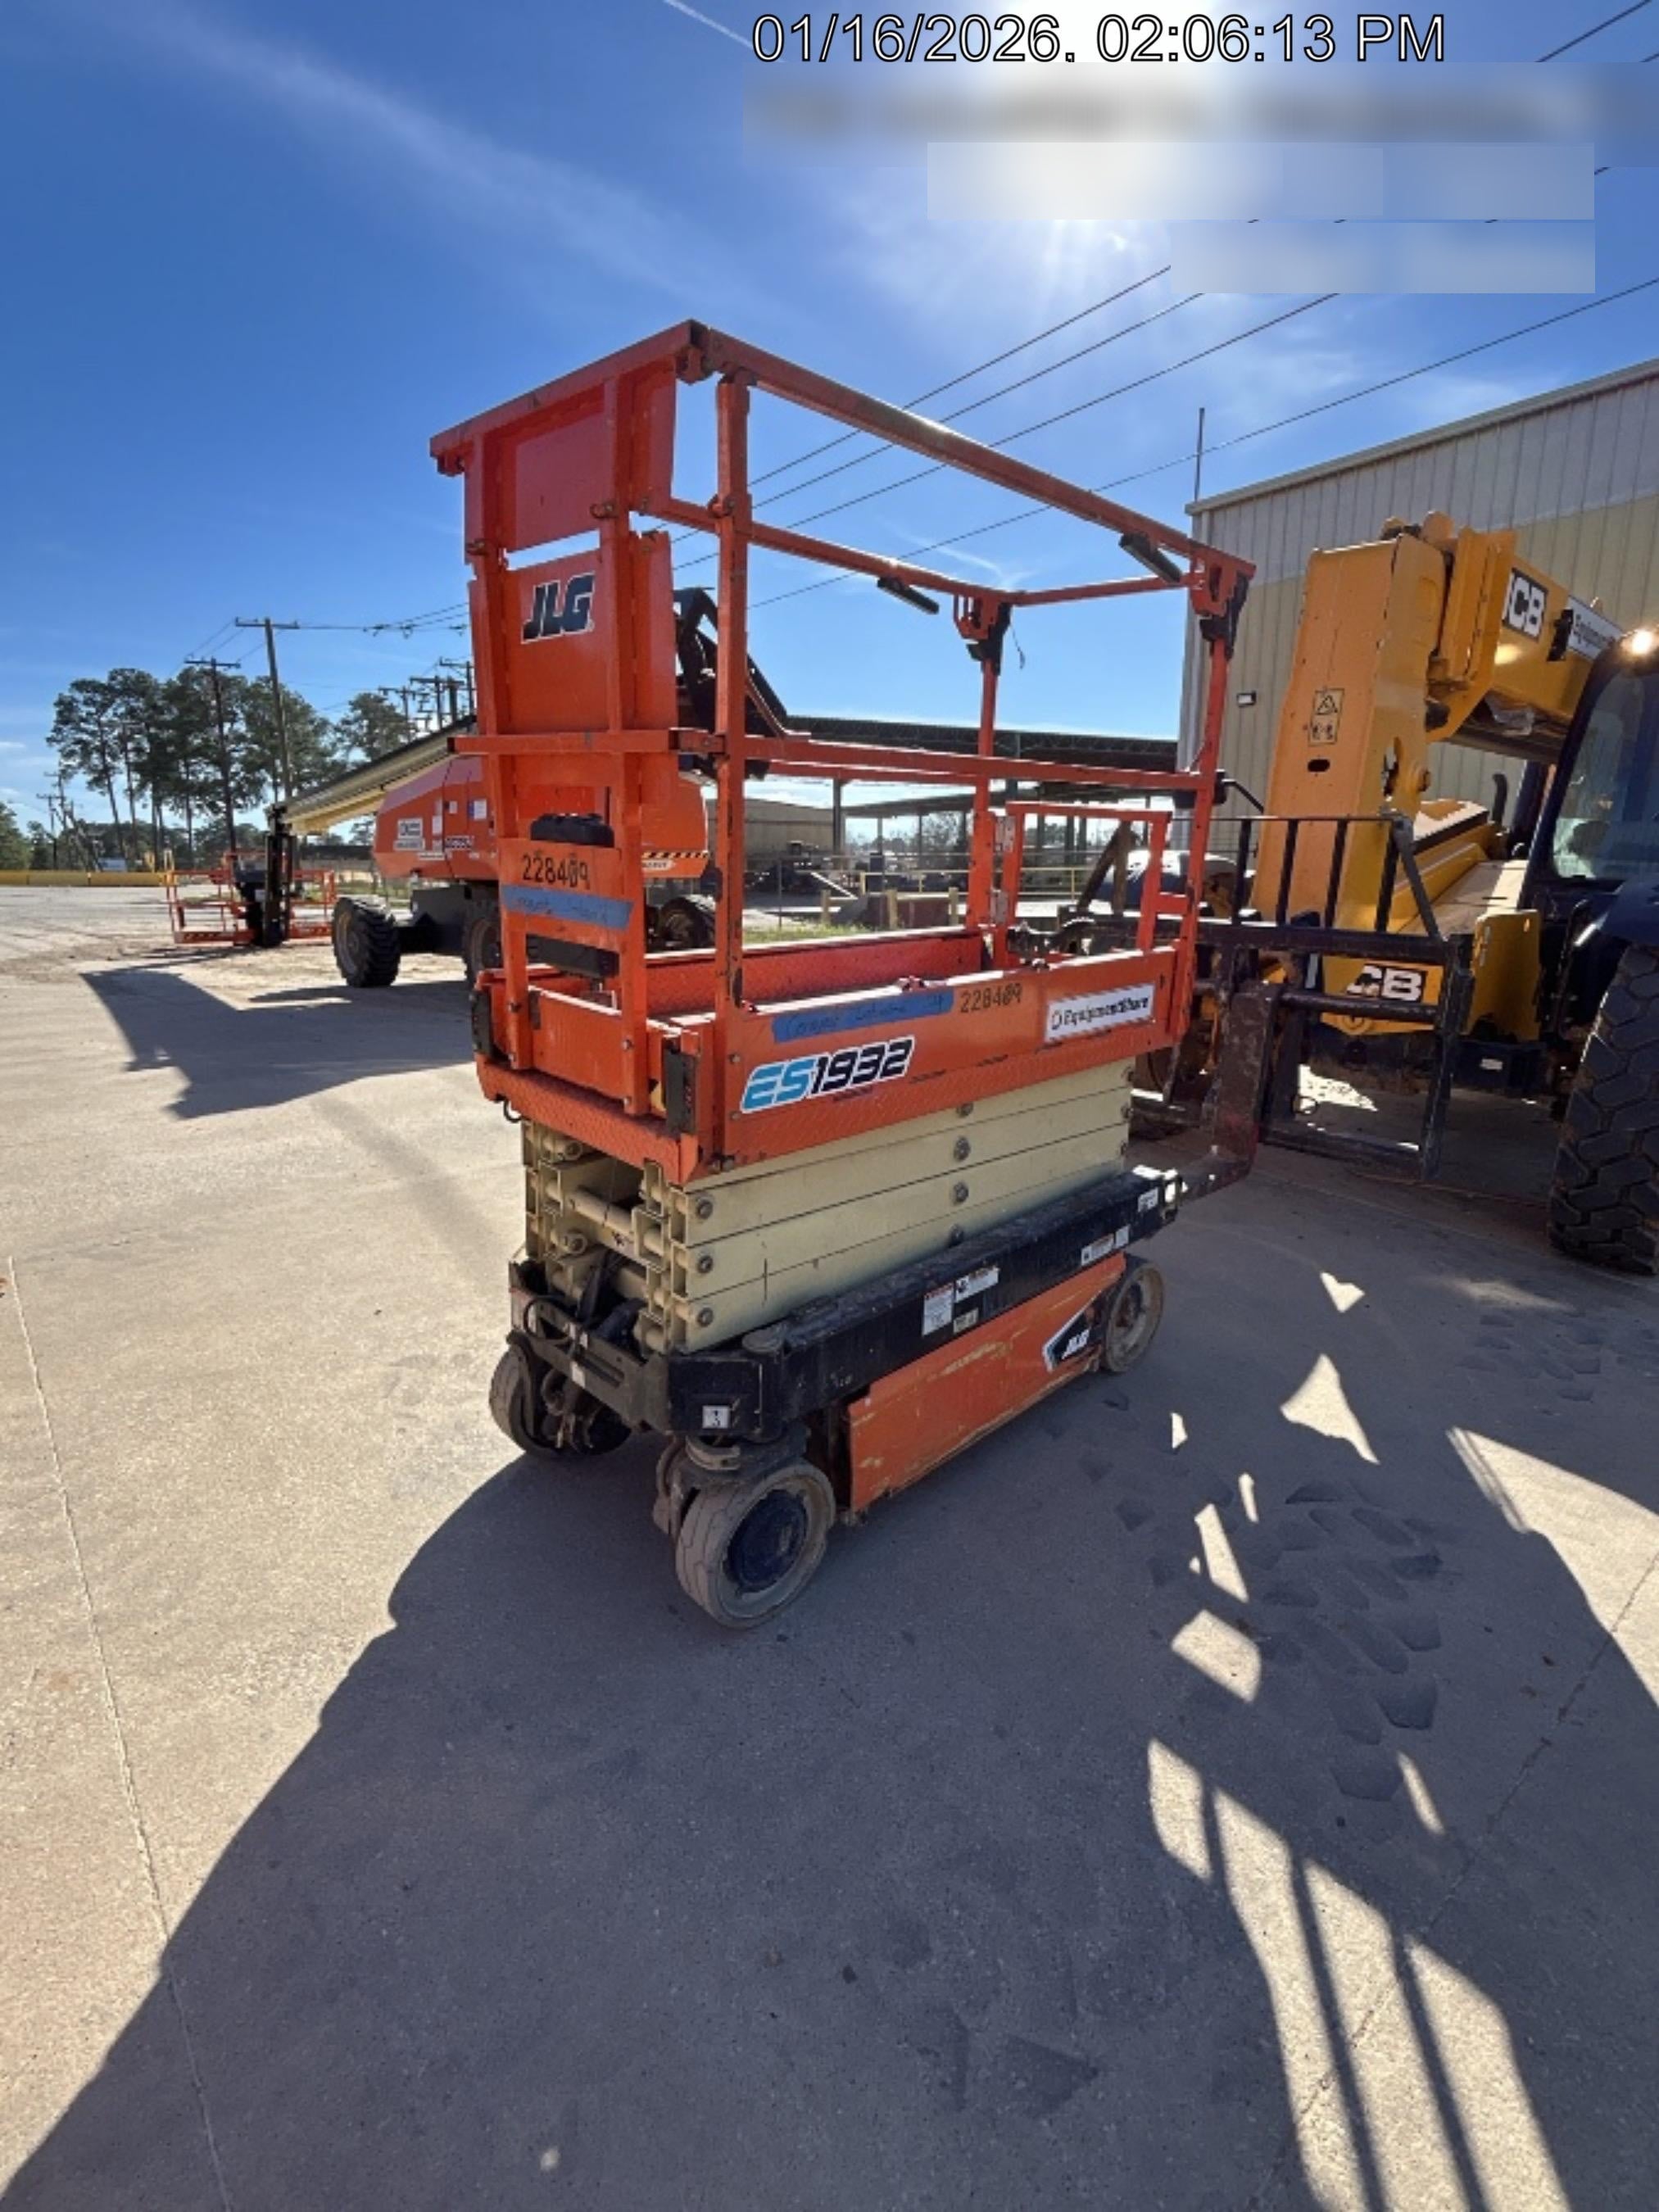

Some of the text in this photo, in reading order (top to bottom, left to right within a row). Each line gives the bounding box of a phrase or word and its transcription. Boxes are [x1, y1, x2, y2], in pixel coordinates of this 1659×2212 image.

[521, 571, 594, 644] JLG
[959, 982, 1022, 1013] 228409
[741, 1036, 914, 1113] ES1932
